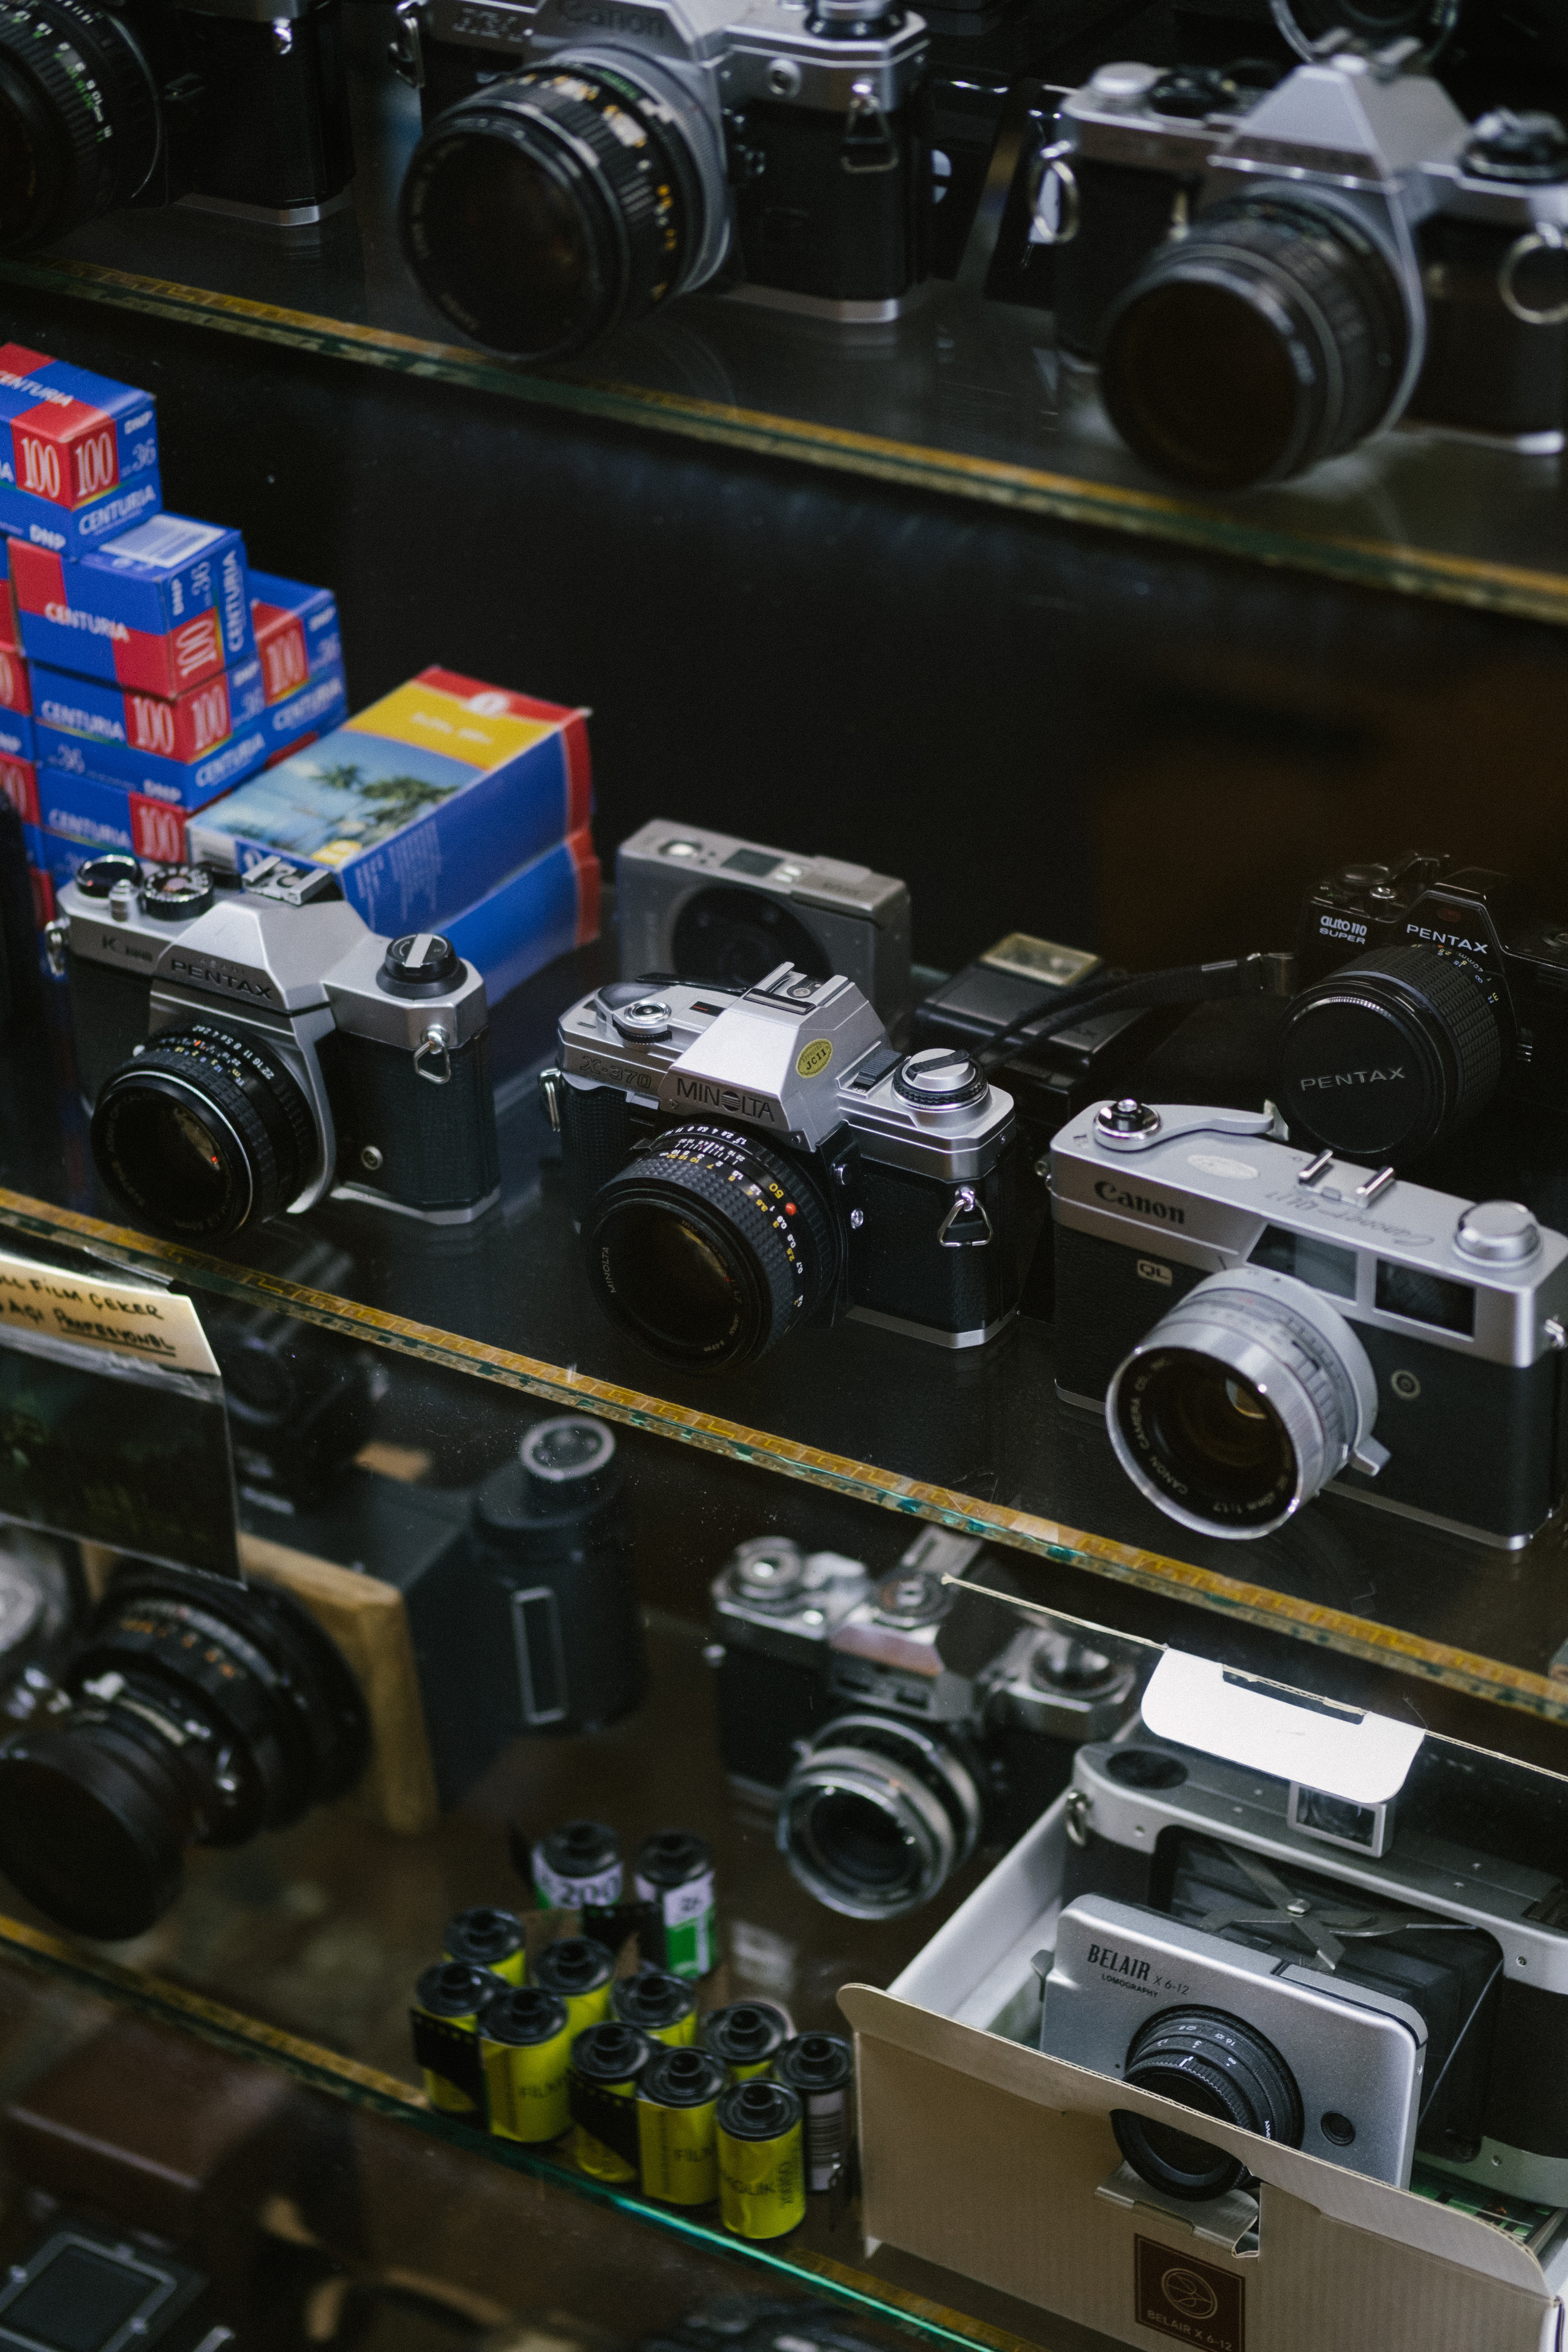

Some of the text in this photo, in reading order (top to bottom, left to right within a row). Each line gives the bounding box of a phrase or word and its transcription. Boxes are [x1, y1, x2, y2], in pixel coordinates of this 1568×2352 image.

[21, 437, 60, 498] 100
[75, 432, 114, 497] 100
[79, 485, 156, 535] CENTURIA
[175, 619, 216, 678] 100
[266, 629, 301, 694] 100
[133, 696, 175, 755] 100
[191, 684, 228, 752] 100
[139, 805, 180, 863] 100
[1319, 927, 1366, 944] SUPER
[1321, 916, 1367, 936] auto 110
[1406, 924, 1488, 954] PENTAX
[171, 959, 273, 1001] PENTAX
[1458, 952, 1483, 973] 40mm
[243, 1049, 254, 1059] 11
[252, 1057, 264, 1069] 16
[262, 1066, 275, 1080] 22
[579, 1055, 652, 1089] X-370
[807, 1049, 826, 1070] JCII
[1301, 1067, 1404, 1091] PENTAX
[676, 1077, 777, 1123] MINOLTA
[769, 1182, 785, 1199] 50
[1094, 1180, 1185, 1225] Canon
[602, 1246, 617, 1294] MINOLTA
[1139, 1263, 1169, 1281] QL
[1151, 1455, 1188, 1494] CANON
[1087, 1943, 1189, 1996] BELAIR X 6-12
[1101, 1973, 1158, 1998] LOMOGRAPHY
[1147, 2310, 1232, 2351] BELAIR X 6-12
